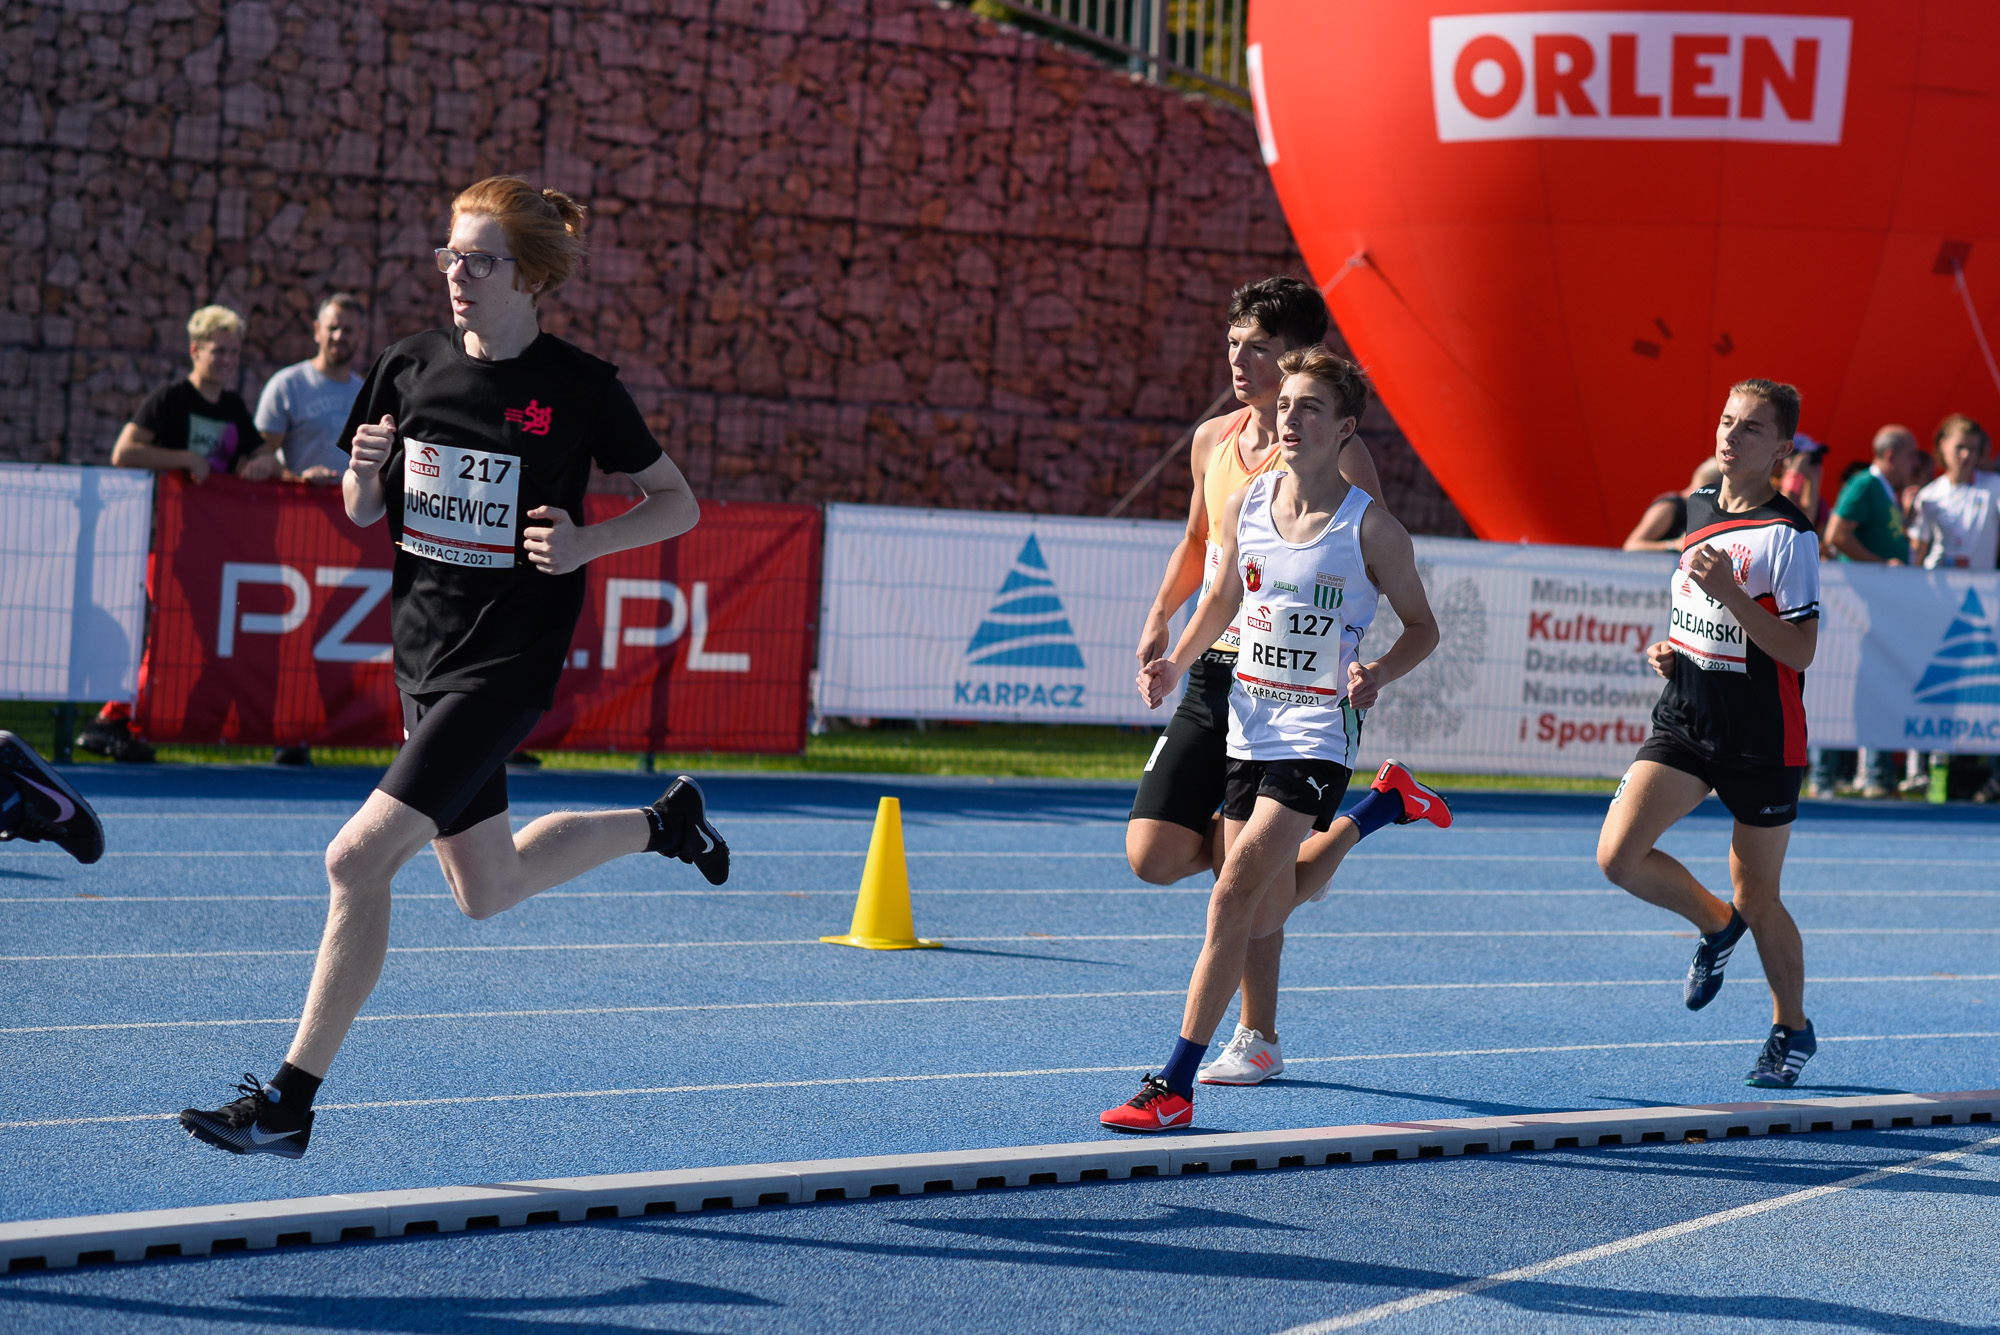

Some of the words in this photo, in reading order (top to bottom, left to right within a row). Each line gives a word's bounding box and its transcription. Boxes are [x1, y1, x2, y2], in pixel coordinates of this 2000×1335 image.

[1454, 33, 1820, 122] ORLEN
[411, 461, 439, 477] ORLEN
[458, 455, 512, 484] 217
[406, 487, 510, 528] JURGIEWICZ
[412, 540, 460, 562] KARPACZ
[463, 553, 493, 565] 2021
[1531, 577, 1671, 608] Ministerst
[217, 562, 750, 672] PZ.PL
[1248, 617, 1272, 632] ORLEN
[1288, 613, 1334, 637] 127
[1672, 607, 1742, 644] OLEJARSKI
[1529, 611, 1653, 654] Kultury
[1252, 642, 1318, 672] REETZ
[1525, 649, 1652, 677] Dziedzict
[1708, 661, 1731, 670] 2021
[955, 681, 1086, 707] KARPACZ
[1246, 684, 1292, 702] KARPACZ
[1295, 694, 1320, 705] 2021
[1520, 717, 1527, 741] i
[1537, 711, 1644, 750] Sportu
[1904, 715, 2000, 741] KARPAC
